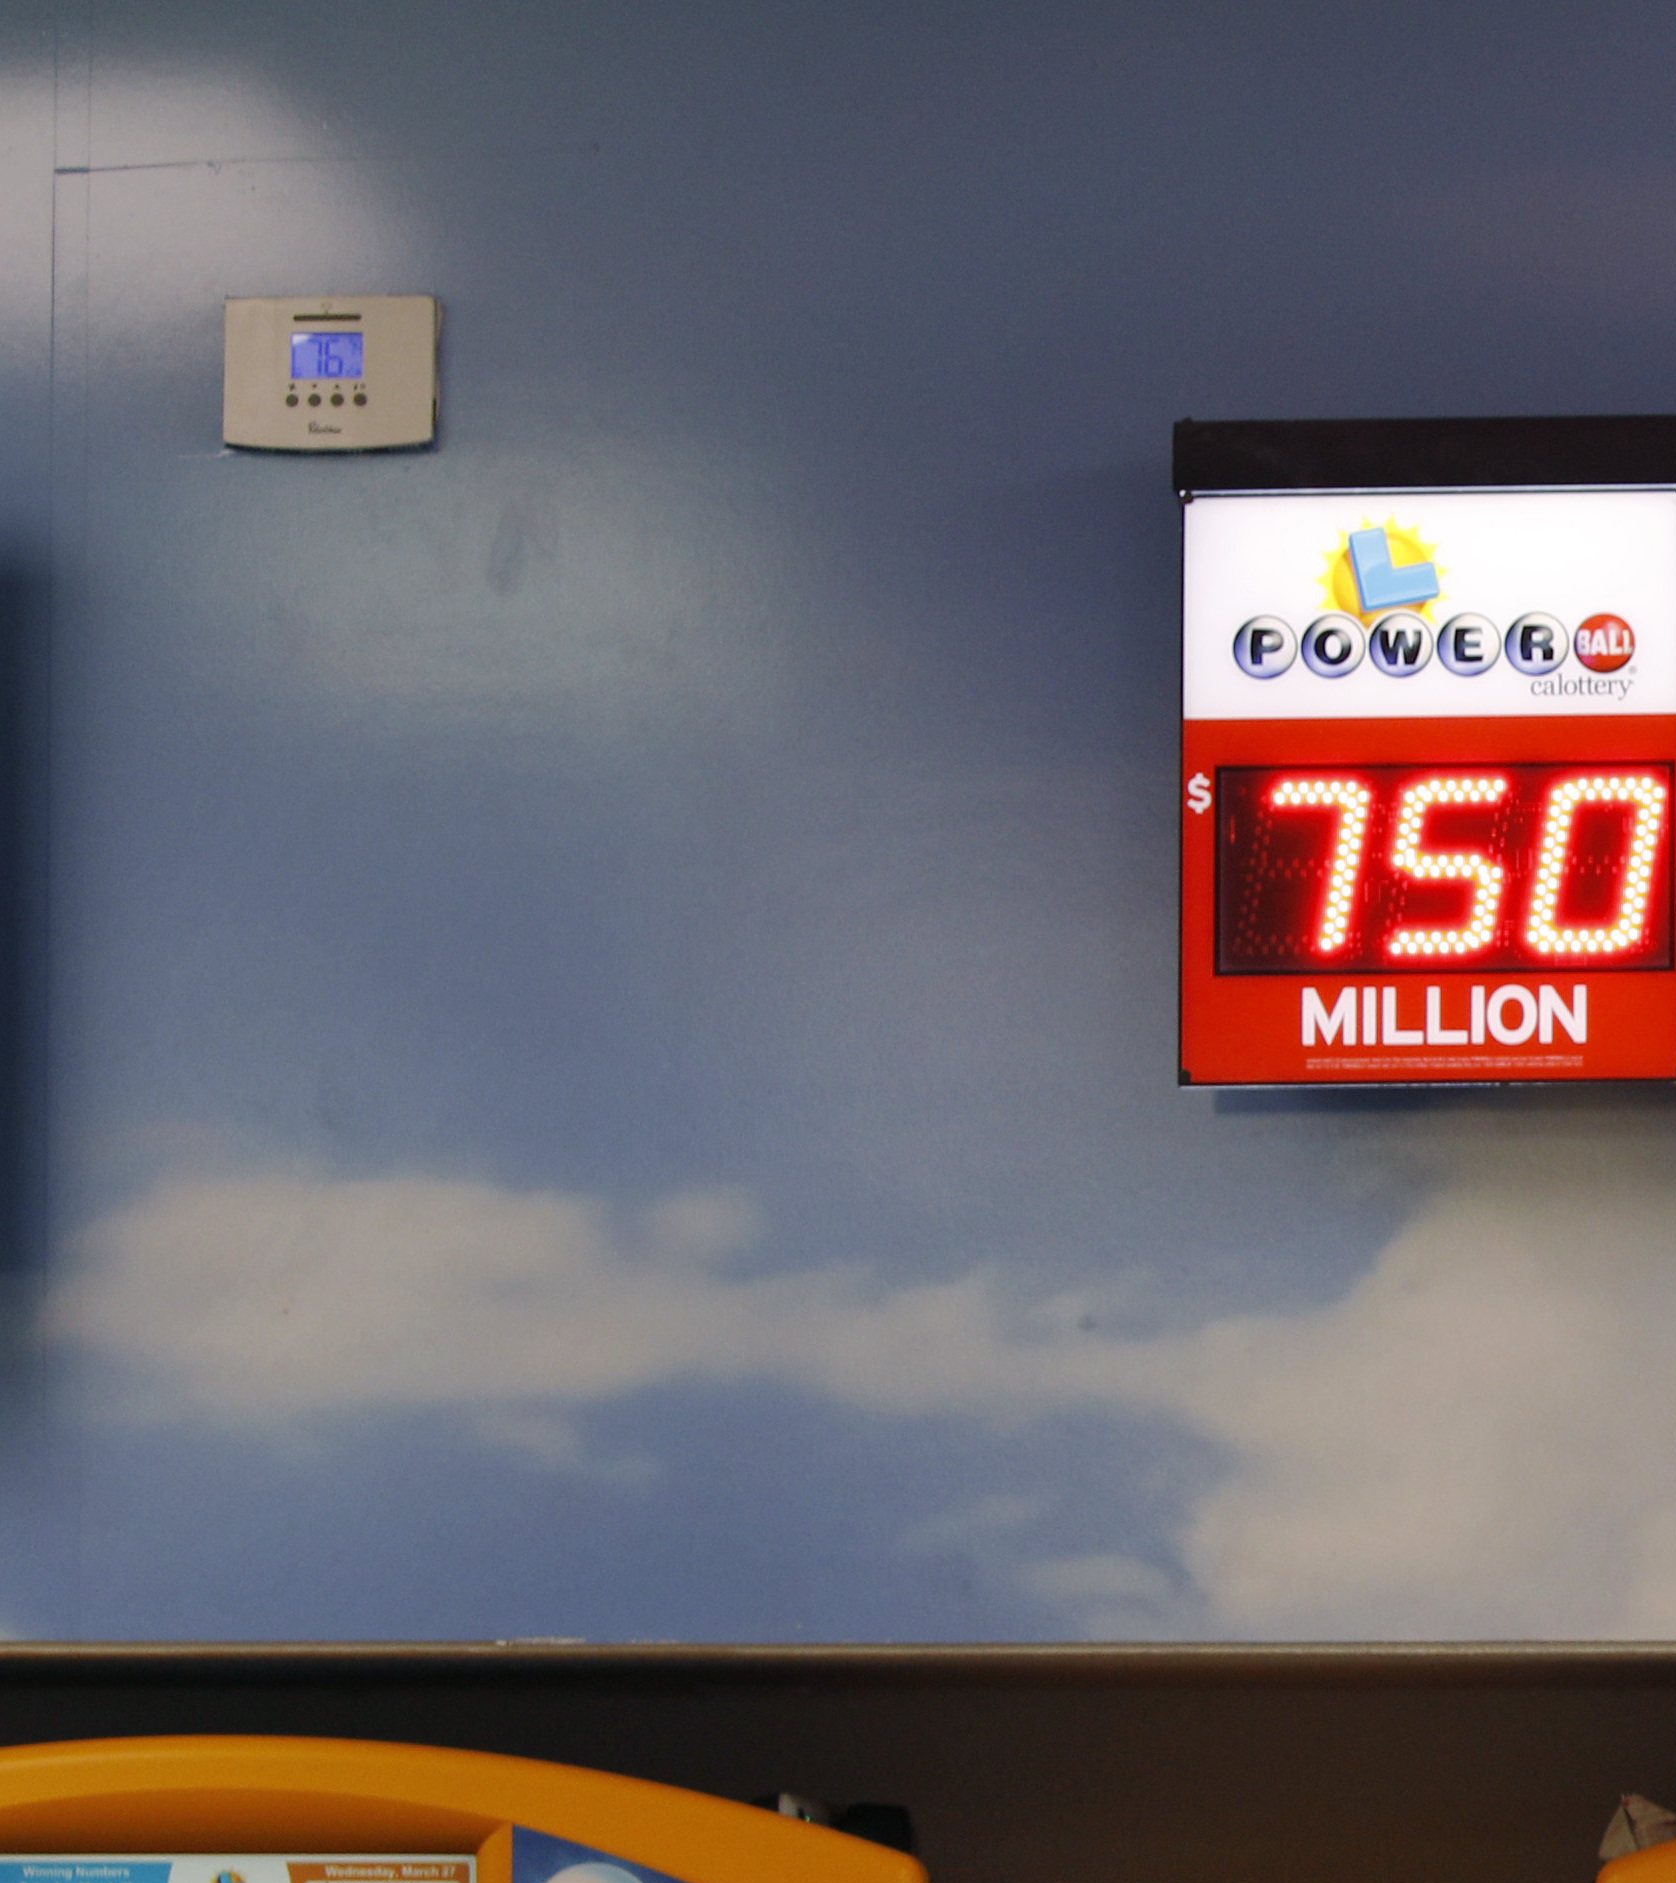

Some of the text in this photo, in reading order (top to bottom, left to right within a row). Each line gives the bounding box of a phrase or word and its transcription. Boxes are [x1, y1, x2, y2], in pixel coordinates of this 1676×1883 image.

[308, 337, 344, 378] 76
[1530, 673, 1637, 700] calottery
[1186, 770, 1666, 956] $ 750
[1300, 981, 1588, 1048] MILLION
[23, 1866, 130, 1879] Winning Numbers
[402, 1865, 439, 1876] March
